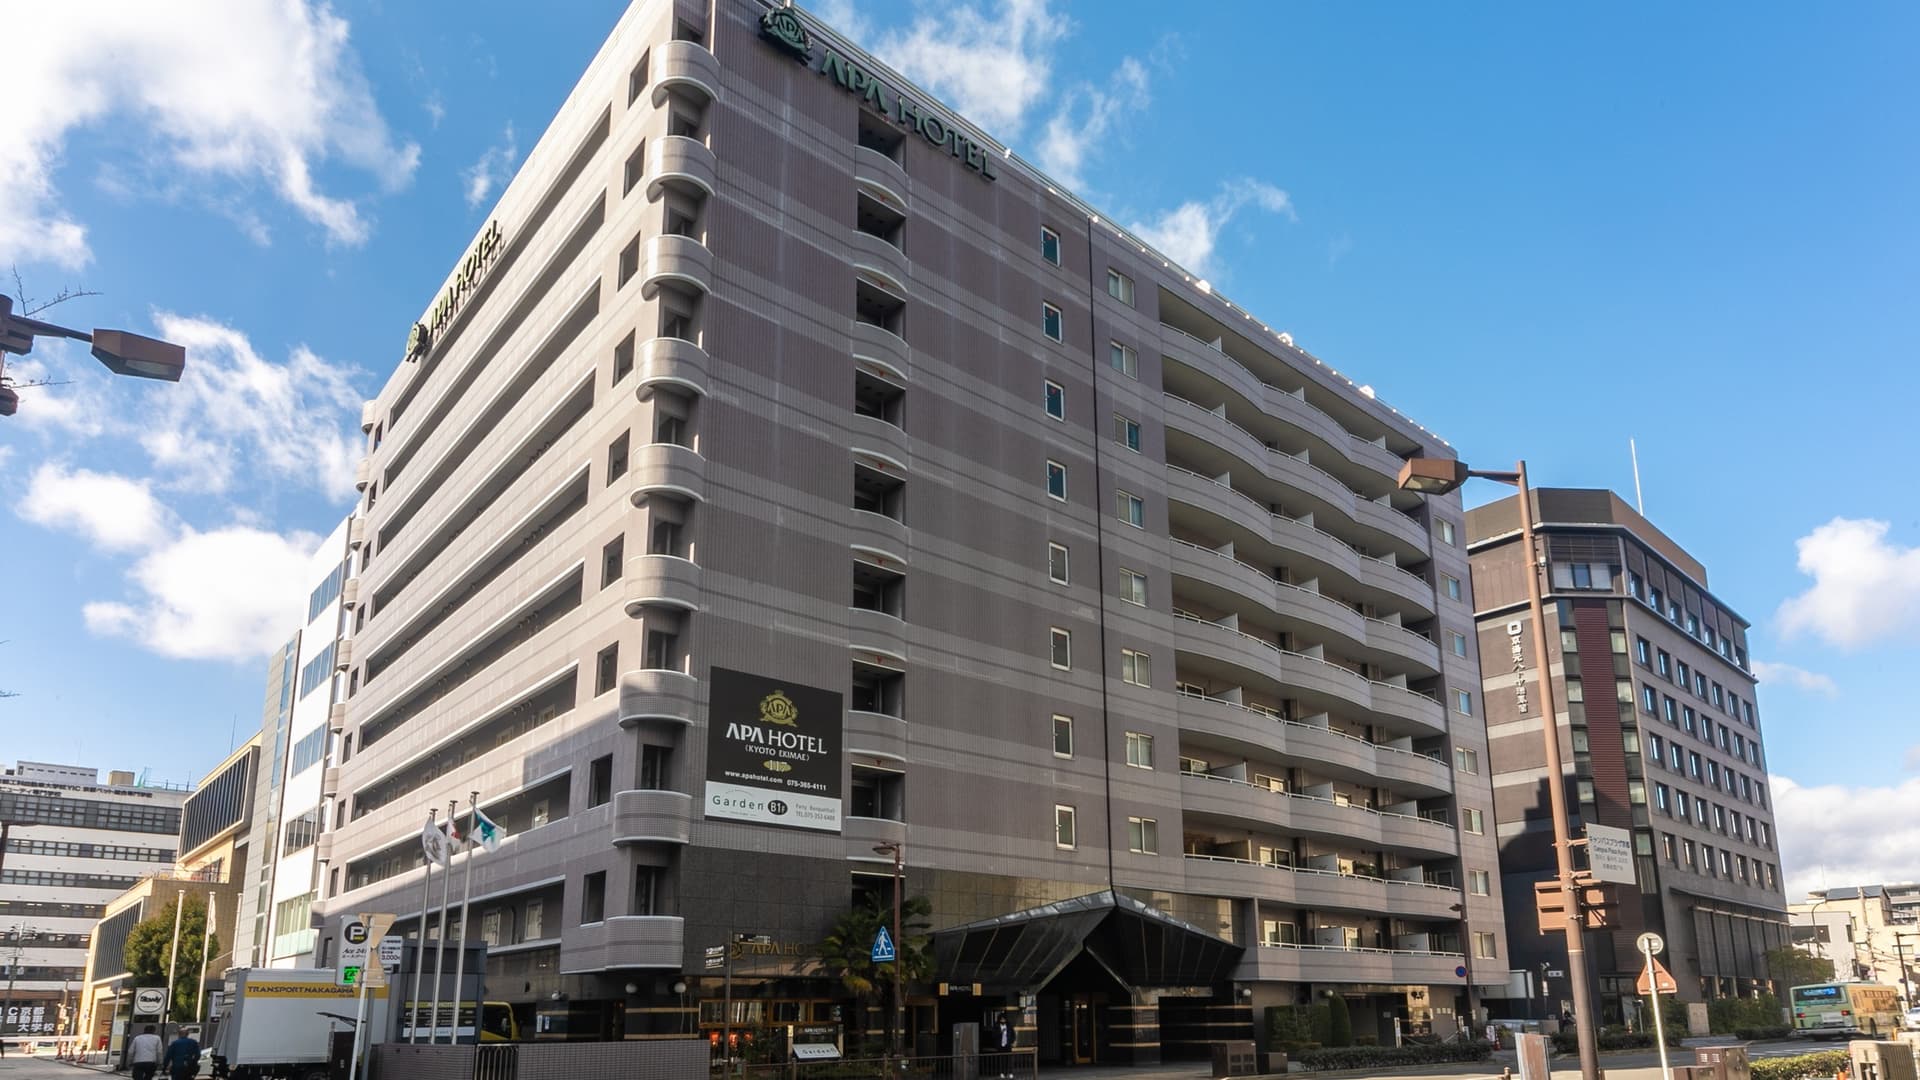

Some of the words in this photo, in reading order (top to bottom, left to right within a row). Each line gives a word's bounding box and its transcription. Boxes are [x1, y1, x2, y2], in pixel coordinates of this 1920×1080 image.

[820, 49, 889, 114] APA
[898, 95, 997, 181] HOTEL
[767, 702, 792, 717] APA
[726, 722, 764, 744] APA
[769, 729, 827, 755] HOTEL
[745, 744, 776, 756] (KYOTO
[725, 770, 783, 784] www.apahotel.com
[712, 795, 764, 811] Garden
[350, 926, 365, 940] P
[248, 985, 303, 993] TRANSPORT
[304, 986, 354, 994] NAKAGAWA
[17, 1022, 55, 1032] 大学校
